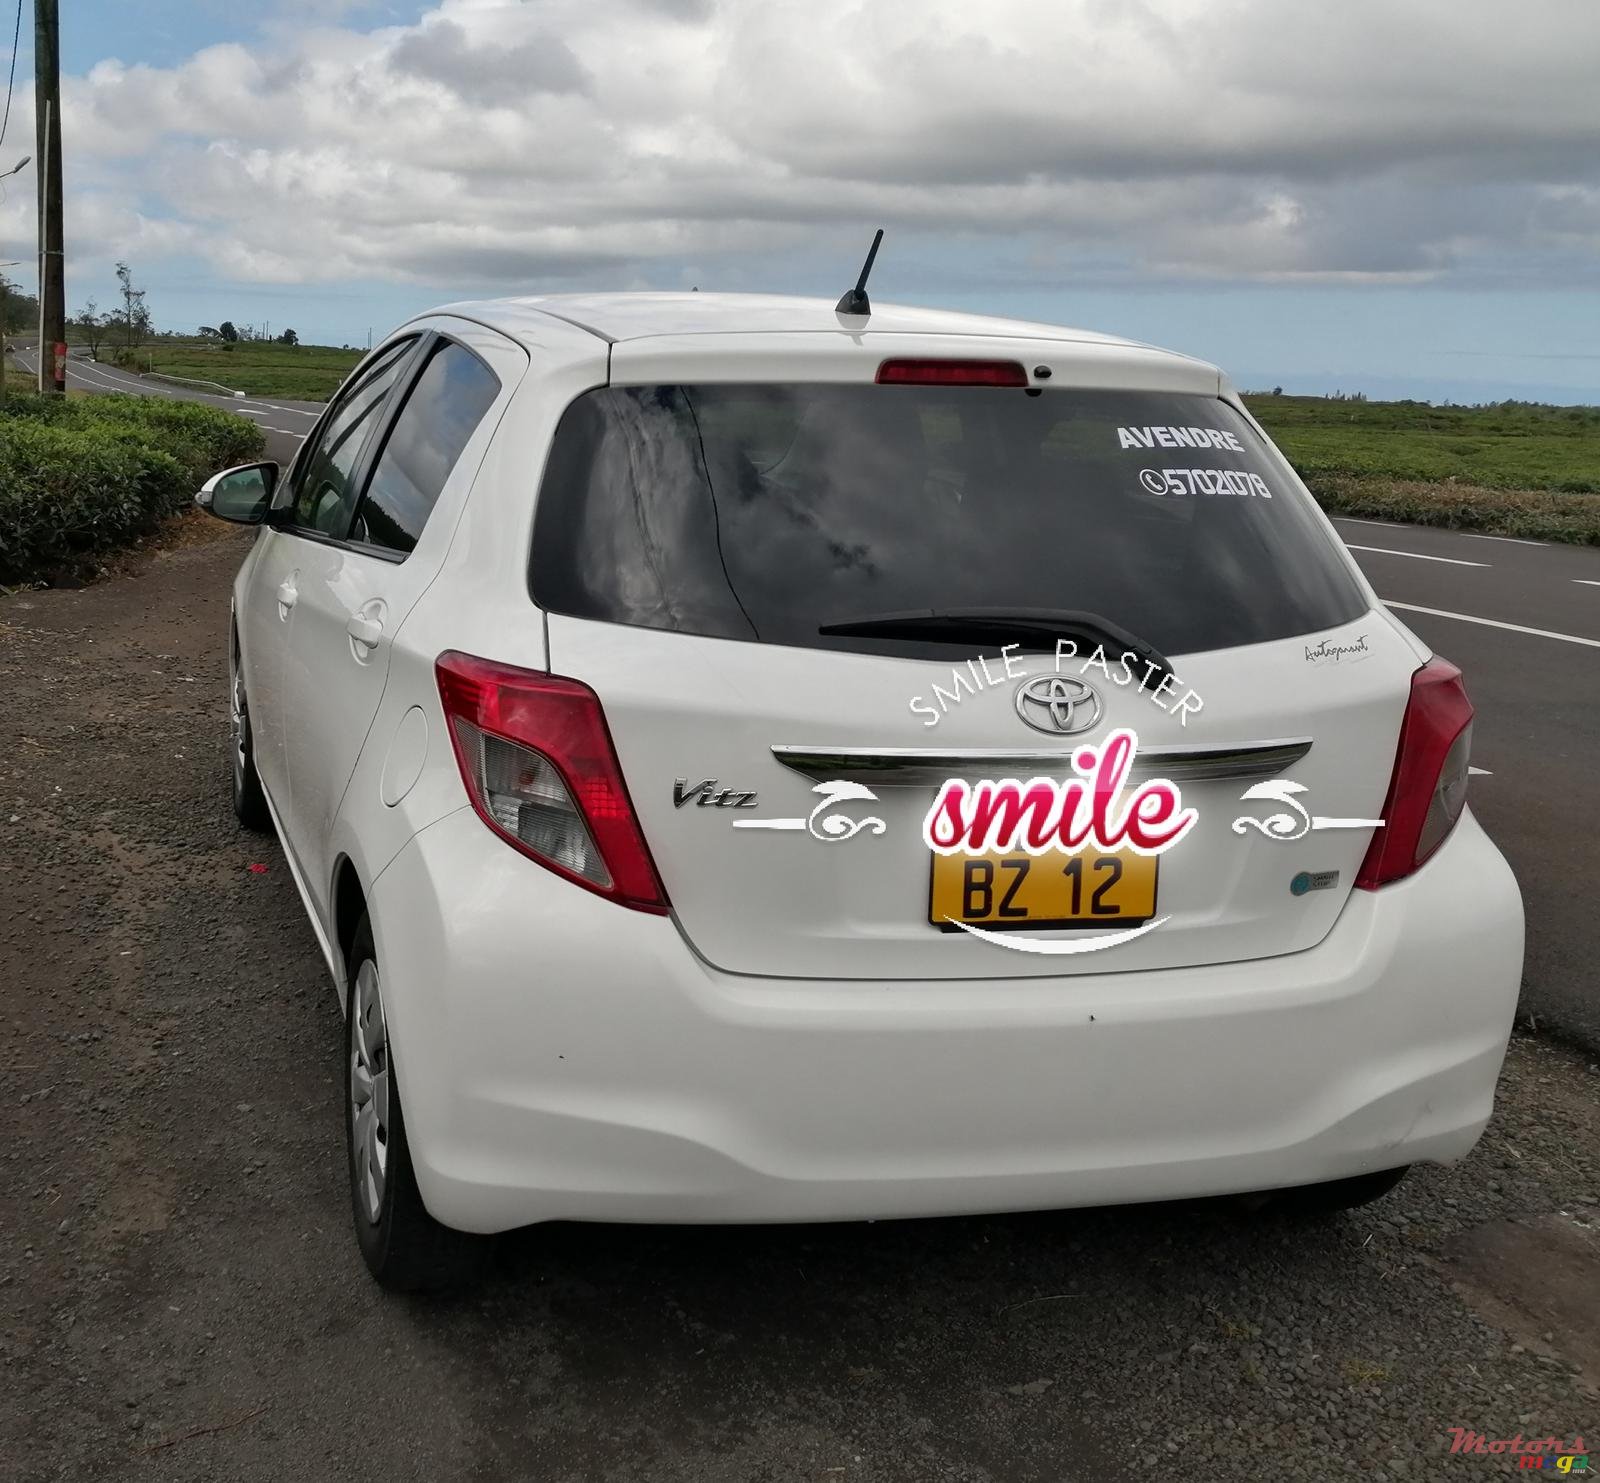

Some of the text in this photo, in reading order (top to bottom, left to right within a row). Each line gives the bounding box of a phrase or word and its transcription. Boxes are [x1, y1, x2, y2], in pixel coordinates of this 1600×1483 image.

[1162, 468, 1273, 499] 57021078
[673, 777, 759, 809] Vitz
[962, 857, 1123, 918] BZ 12
